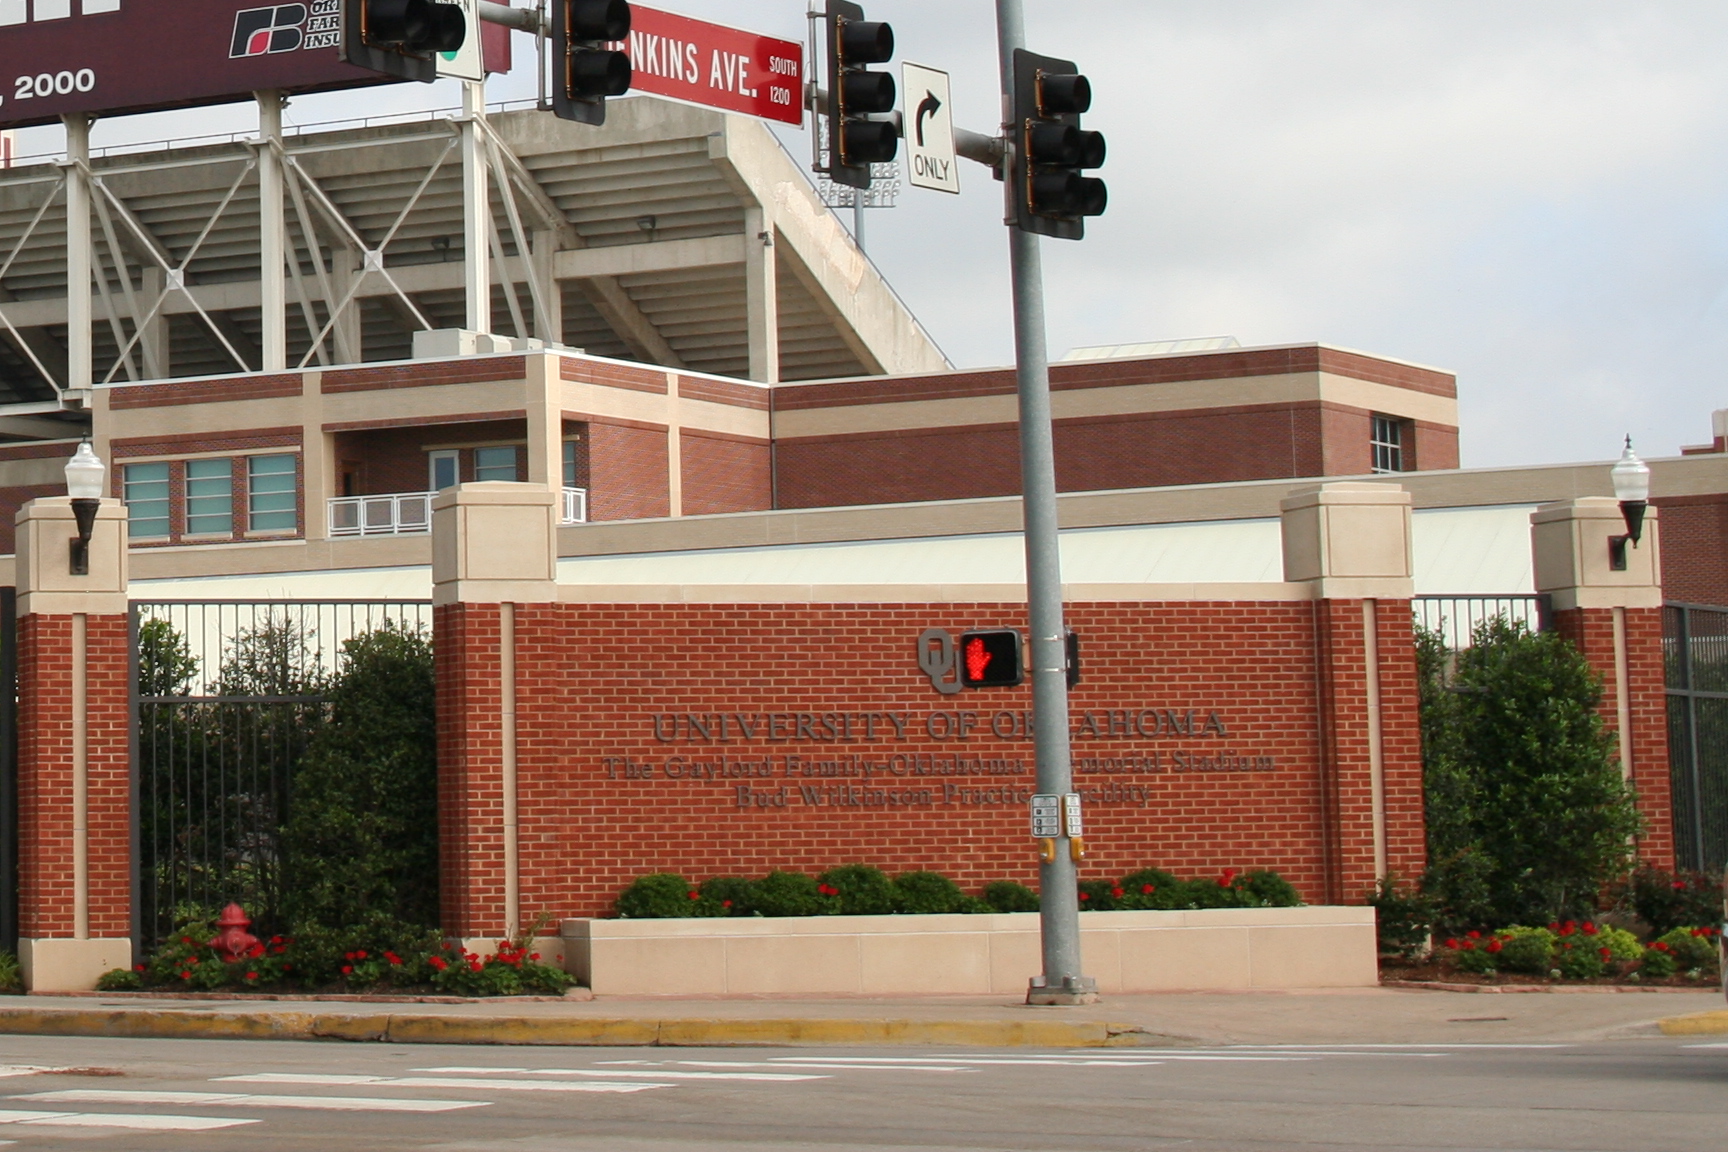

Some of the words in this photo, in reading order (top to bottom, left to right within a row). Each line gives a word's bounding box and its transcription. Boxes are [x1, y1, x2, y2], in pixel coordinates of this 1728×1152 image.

[608, 30, 698, 84] NKINS
[709, 49, 758, 98] AVE.
[769, 55, 797, 77] SOUTH
[14, 68, 95, 100] 2000
[770, 85, 790, 106] 1200
[914, 154, 949, 181] ONLY
[652, 711, 912, 743] UNIVERSITY
[927, 710, 977, 740] OF
[992, 708, 1226, 739] OAHOMA
[603, 756, 653, 779] The
[665, 754, 772, 783] Gaylord
[1070, 749, 1161, 774] morial
[1171, 749, 1275, 773] Stadium
[736, 784, 788, 808] Bud
[799, 783, 932, 807] Wilkinson
[943, 782, 1030, 805] Practic
[1078, 780, 1151, 809] cility
